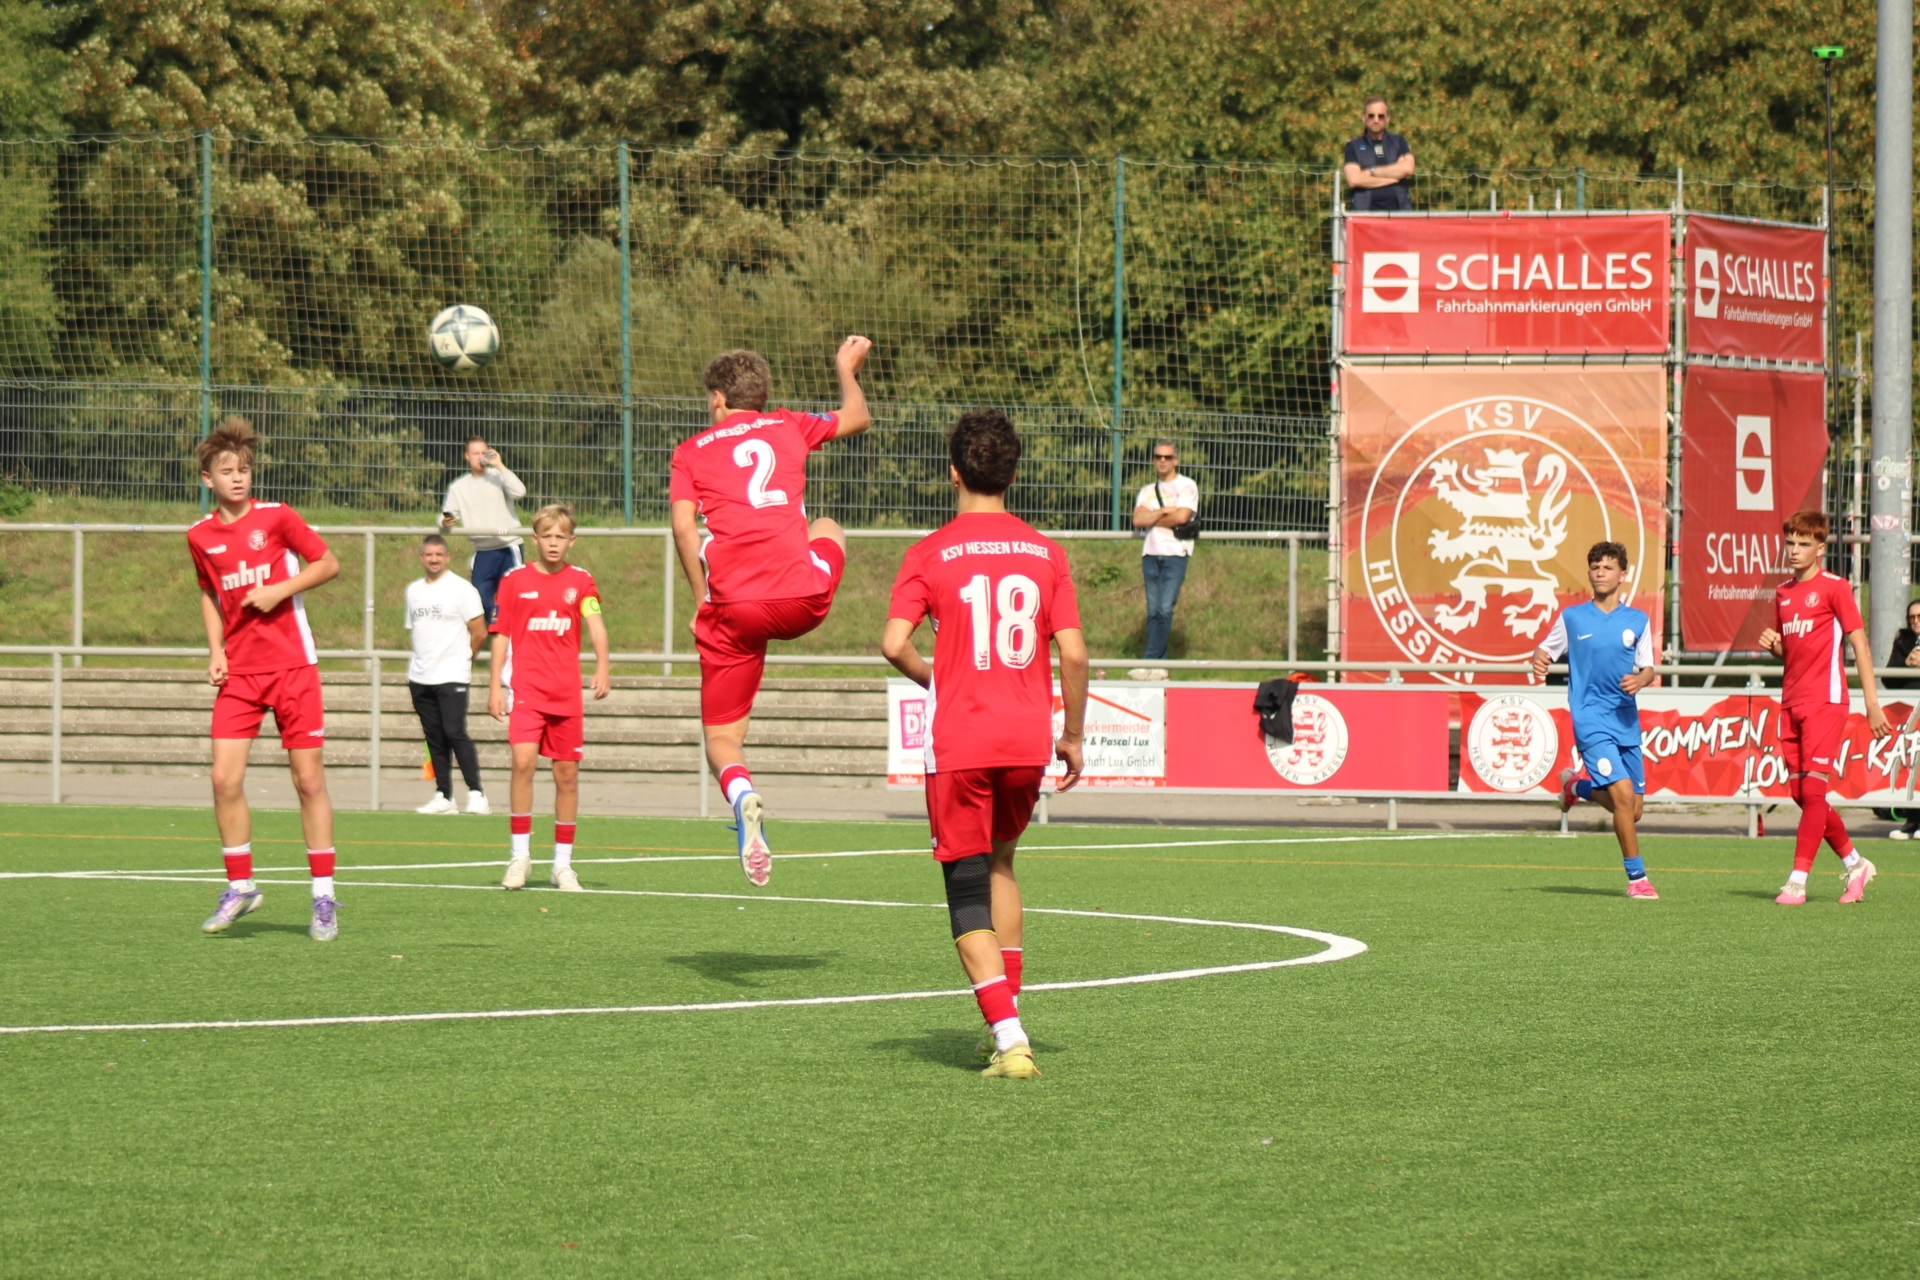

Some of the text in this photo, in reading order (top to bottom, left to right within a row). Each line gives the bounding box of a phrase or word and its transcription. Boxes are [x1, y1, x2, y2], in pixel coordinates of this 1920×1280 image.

[1435, 252, 1653, 291] SCHALLES
[1724, 253, 1815, 303] SCHALLES
[1436, 298, 1652, 316] Fahrbahnmarkierungen GmbH
[1724, 305, 1813, 329] Fahrbahnmarkierungen GmbH
[1464, 402, 1543, 432] KSV
[696, 433, 715, 448] KSV
[715, 423, 751, 439] HESSEN
[733, 438, 788, 509] 2
[941, 541, 1051, 562] KSV HESSEN KASSEL
[1706, 532, 1795, 575] SCHALL
[221, 560, 271, 591] mhp
[412, 607, 431, 618] KSV
[528, 610, 572, 637] mhp
[960, 574, 1040, 670] 18
[1369, 559, 1476, 684] HESSEN
[1782, 612, 1814, 638] mhp
[904, 702, 924, 715] WIR
[1296, 695, 1318, 705] KSV
[1501, 696, 1524, 706] KSV
[1101, 736, 1132, 747] Pascal
[1134, 737, 1150, 747] Lux
[1109, 756, 1124, 768] Lux
[1127, 755, 1155, 768] GmbH
[1268, 743, 1347, 782] HESSEN KASSEL
[1472, 746, 1554, 787] HESSEN KASSEL
